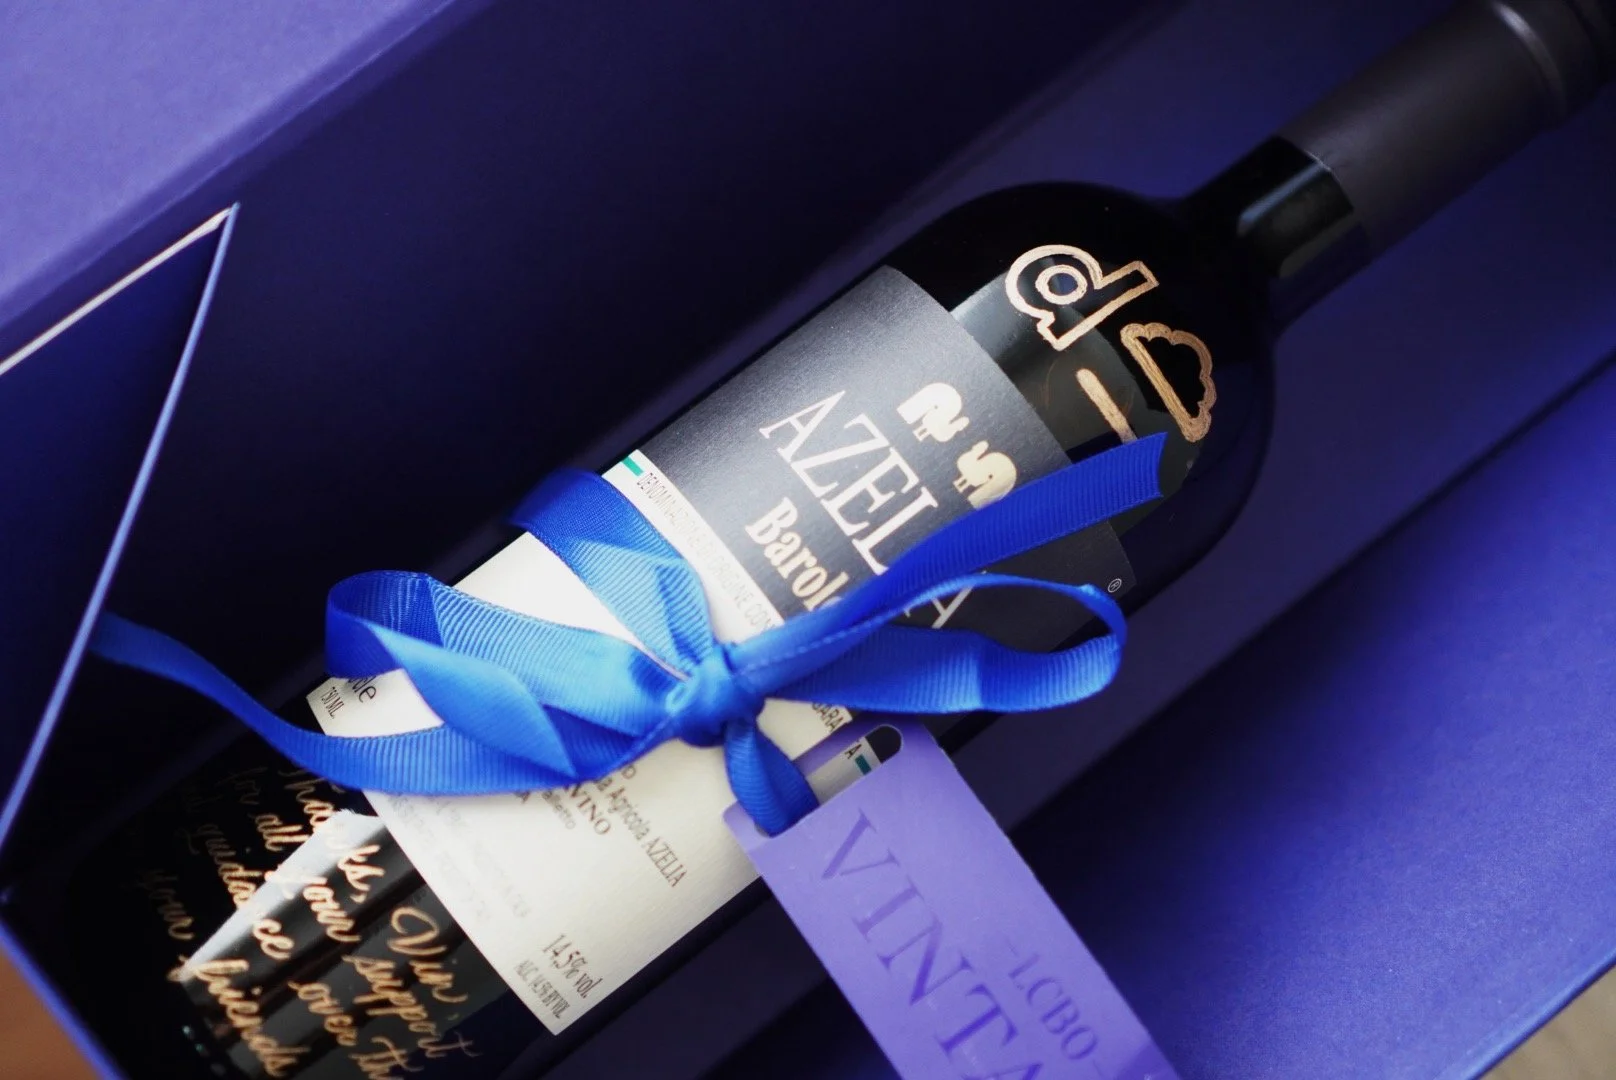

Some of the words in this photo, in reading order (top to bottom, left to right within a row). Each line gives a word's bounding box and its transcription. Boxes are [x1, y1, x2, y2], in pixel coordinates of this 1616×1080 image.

[759, 390, 987, 628] AZELA
[563, 783, 611, 835] VINO
[641, 837, 687, 888] AZELIA
[173, 822, 294, 960] guidace
[288, 980, 358, 1046] over
[165, 953, 311, 1077] friends
[341, 955, 482, 1058] support
[574, 973, 603, 999] vol.
